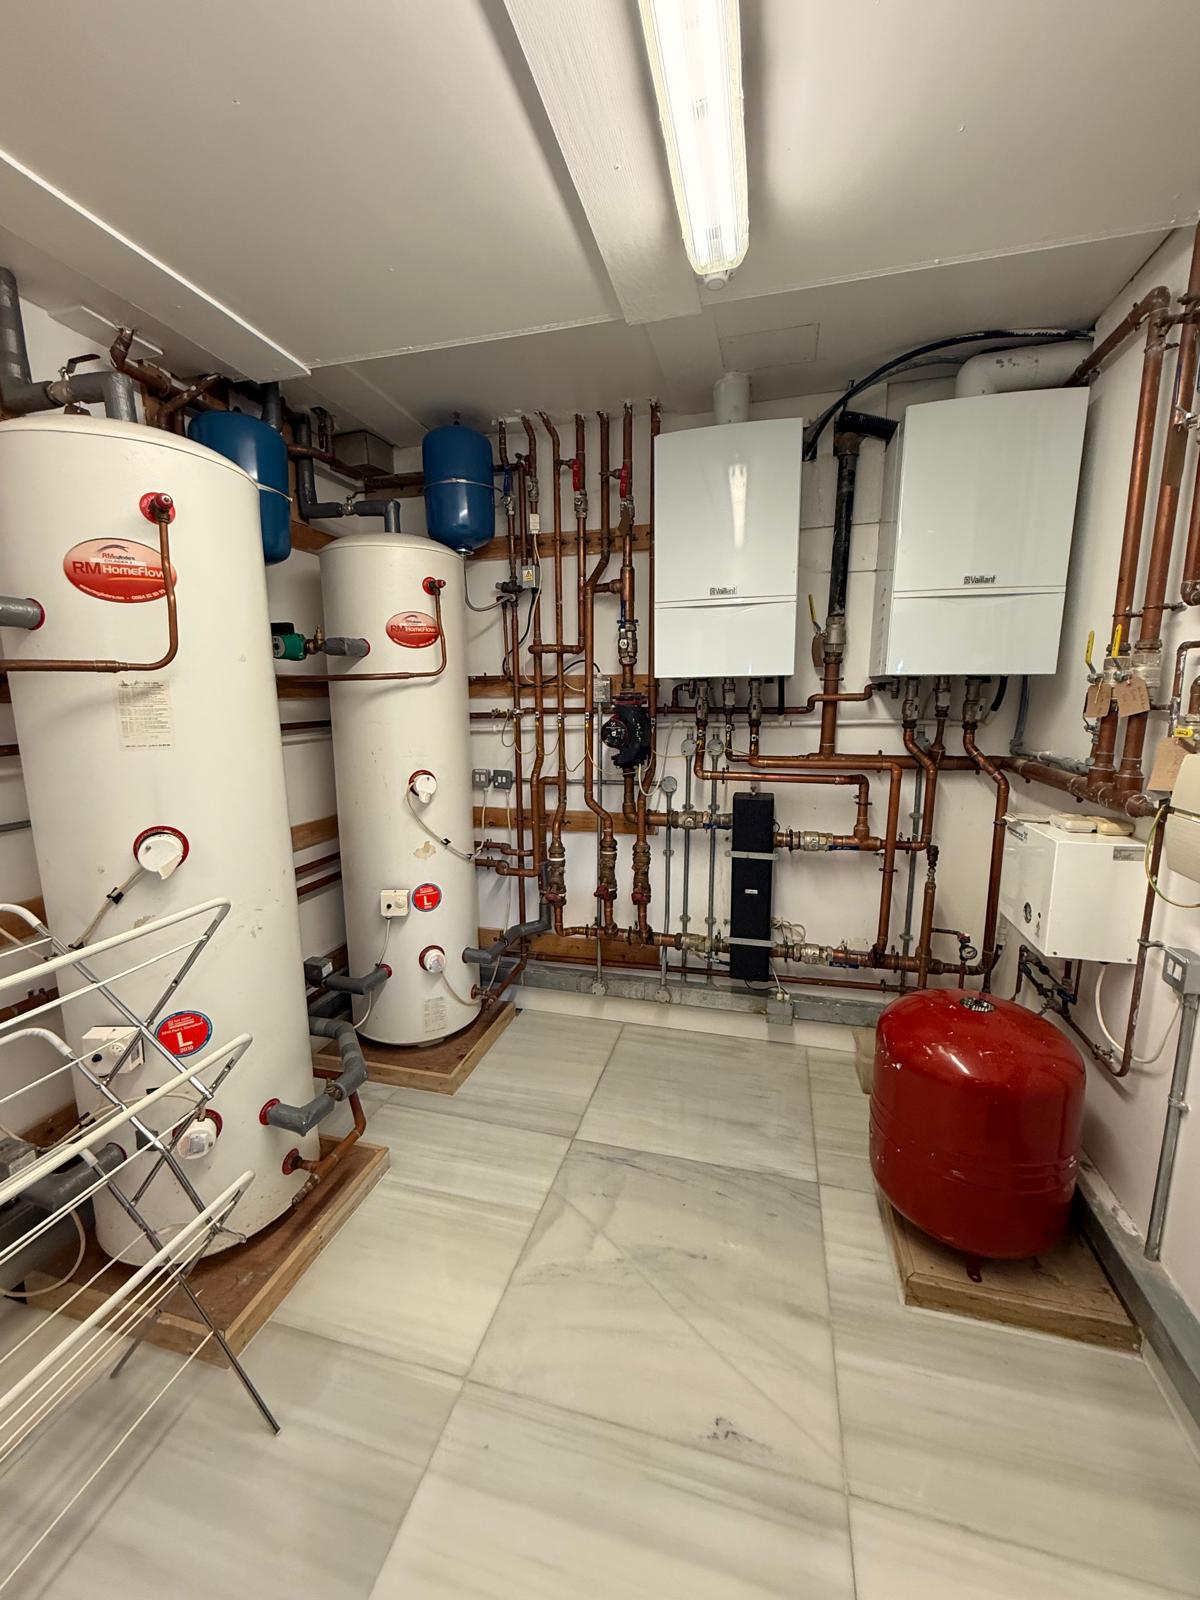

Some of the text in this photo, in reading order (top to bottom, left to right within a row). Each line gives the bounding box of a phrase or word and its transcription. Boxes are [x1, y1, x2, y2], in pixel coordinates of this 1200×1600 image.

[71, 560, 165, 579] RM HomeFlow
[970, 575, 996, 584] Vaillant
[390, 625, 405, 633] RM
[424, 895, 433, 906] L
[176, 1031, 194, 1048] L
